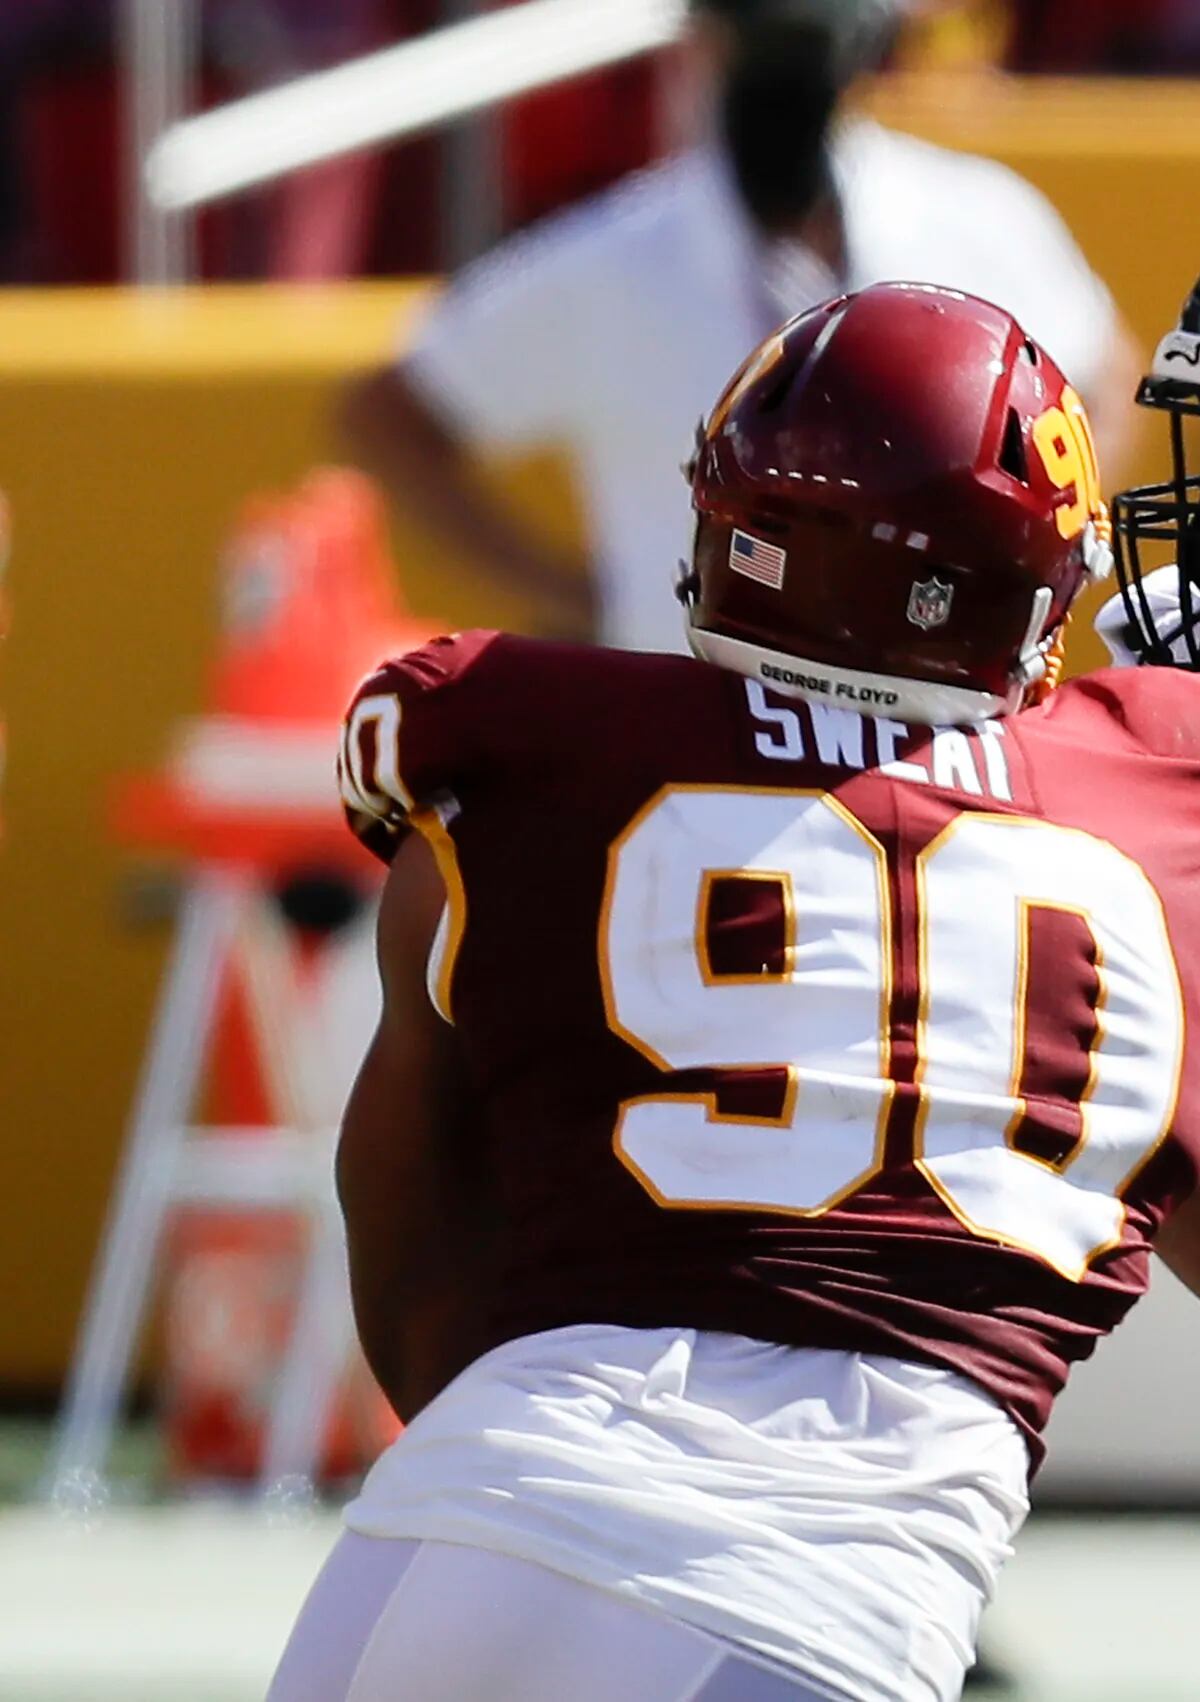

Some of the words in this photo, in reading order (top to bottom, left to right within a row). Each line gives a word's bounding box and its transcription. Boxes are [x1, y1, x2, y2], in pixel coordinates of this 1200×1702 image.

[744, 678, 1014, 802] SWEAT
[760, 662, 832, 695] GEORGE
[835, 681, 899, 705] FLOYD
[597, 782, 1185, 1284] 90
